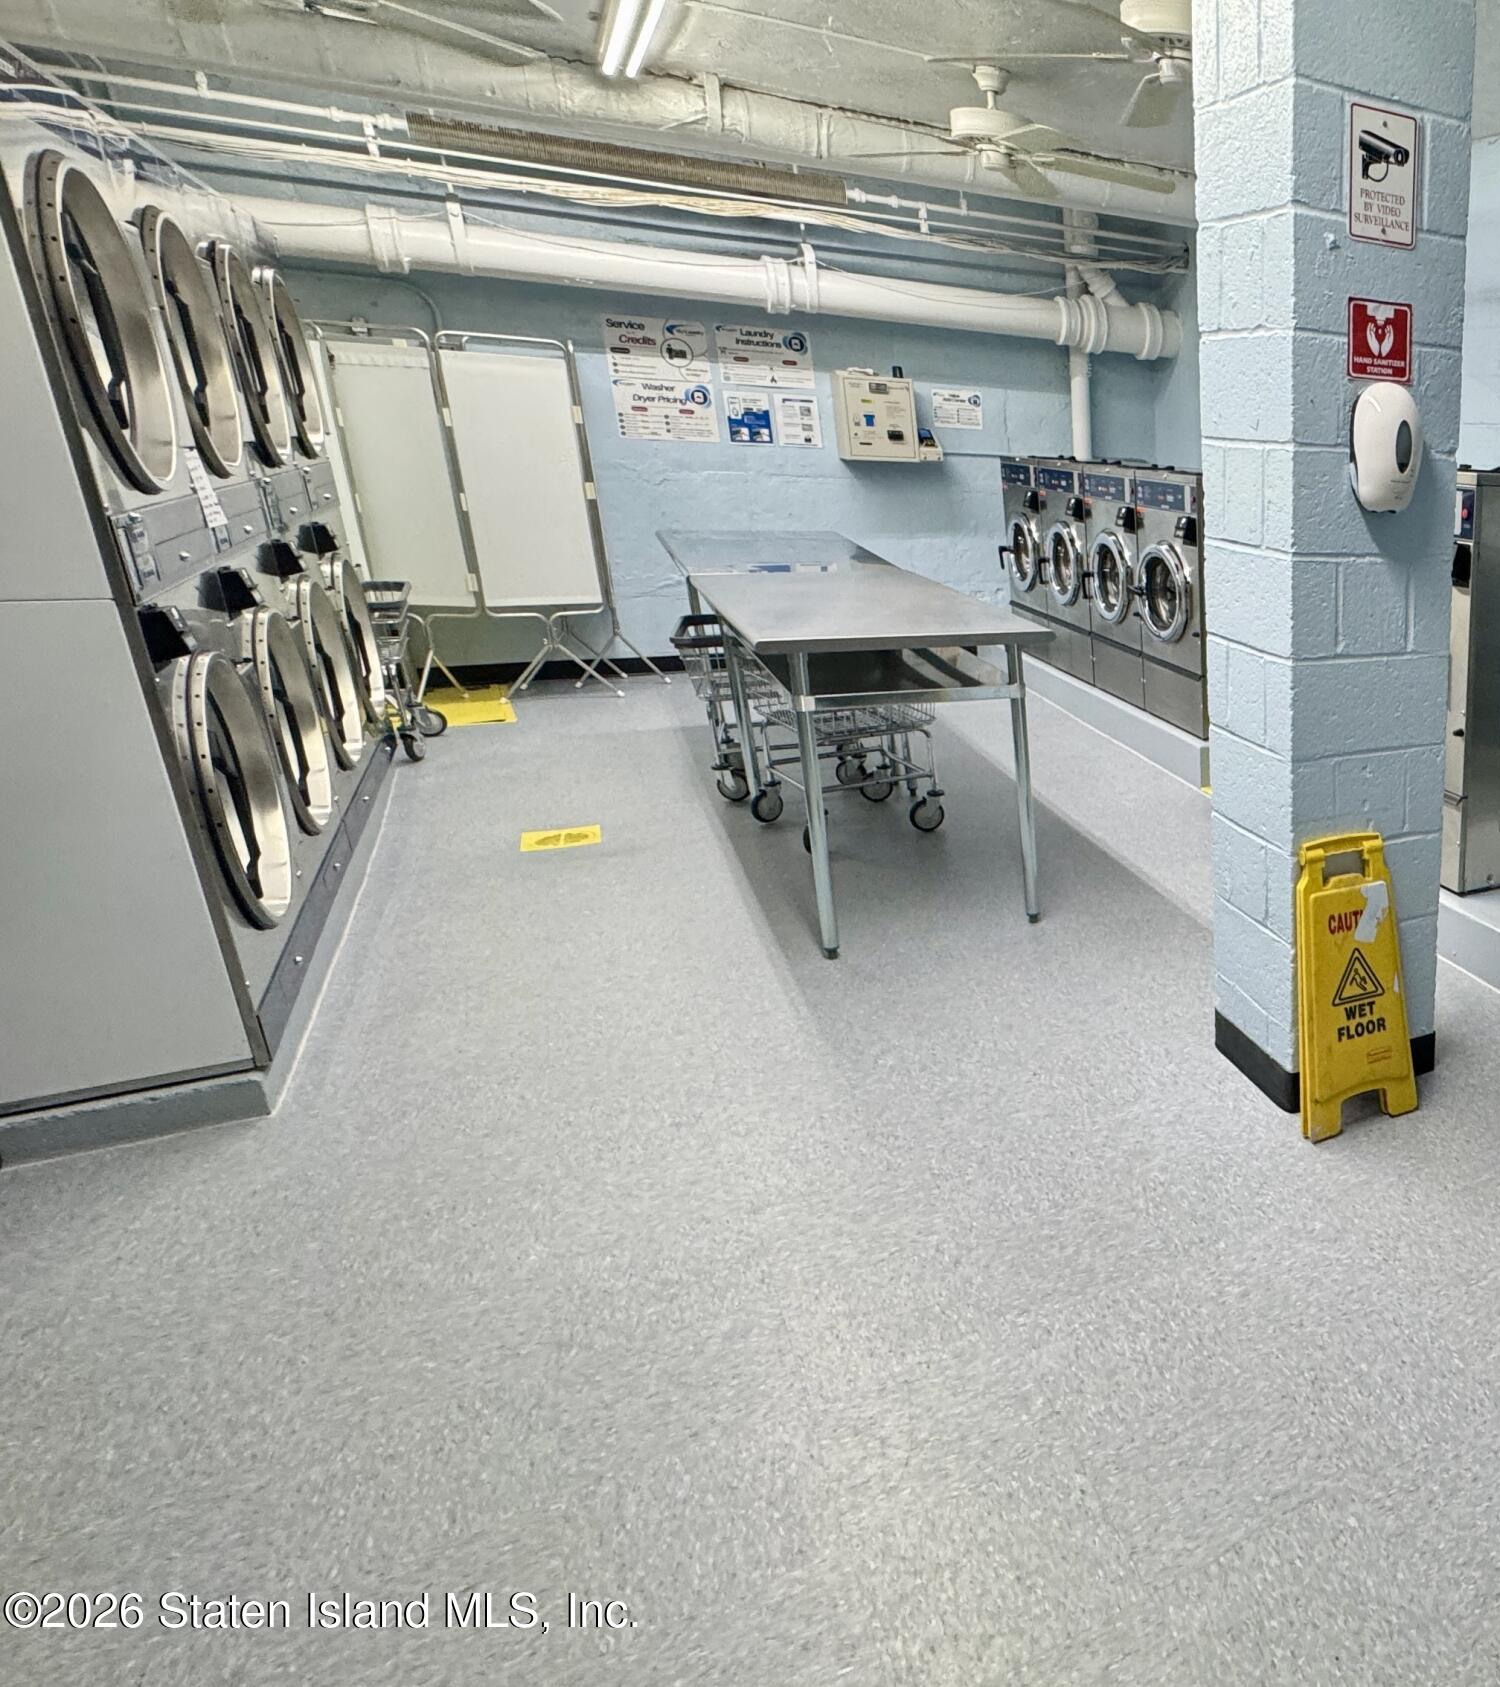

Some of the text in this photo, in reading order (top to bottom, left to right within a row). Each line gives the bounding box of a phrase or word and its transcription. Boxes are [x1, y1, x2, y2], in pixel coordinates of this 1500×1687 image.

[1360, 187, 1406, 206] PROTECTED
[1363, 201, 1402, 218] BY VIDEO
[1353, 212, 1410, 232] SURVEILLANCE
[606, 318, 646, 331] Service
[618, 334, 657, 346] Credits
[739, 327, 775, 340] Laundry
[735, 337, 782, 349] Instructions
[1353, 356, 1405, 368] HAND SANITIZER
[1366, 366, 1393, 375] STATION
[641, 382, 676, 392] Washer
[632, 393, 688, 406] Dryer Pricing
[1328, 909, 1364, 936] CAUT
[1344, 1001, 1376, 1021] WET
[1337, 1017, 1387, 1043] FLOOR
